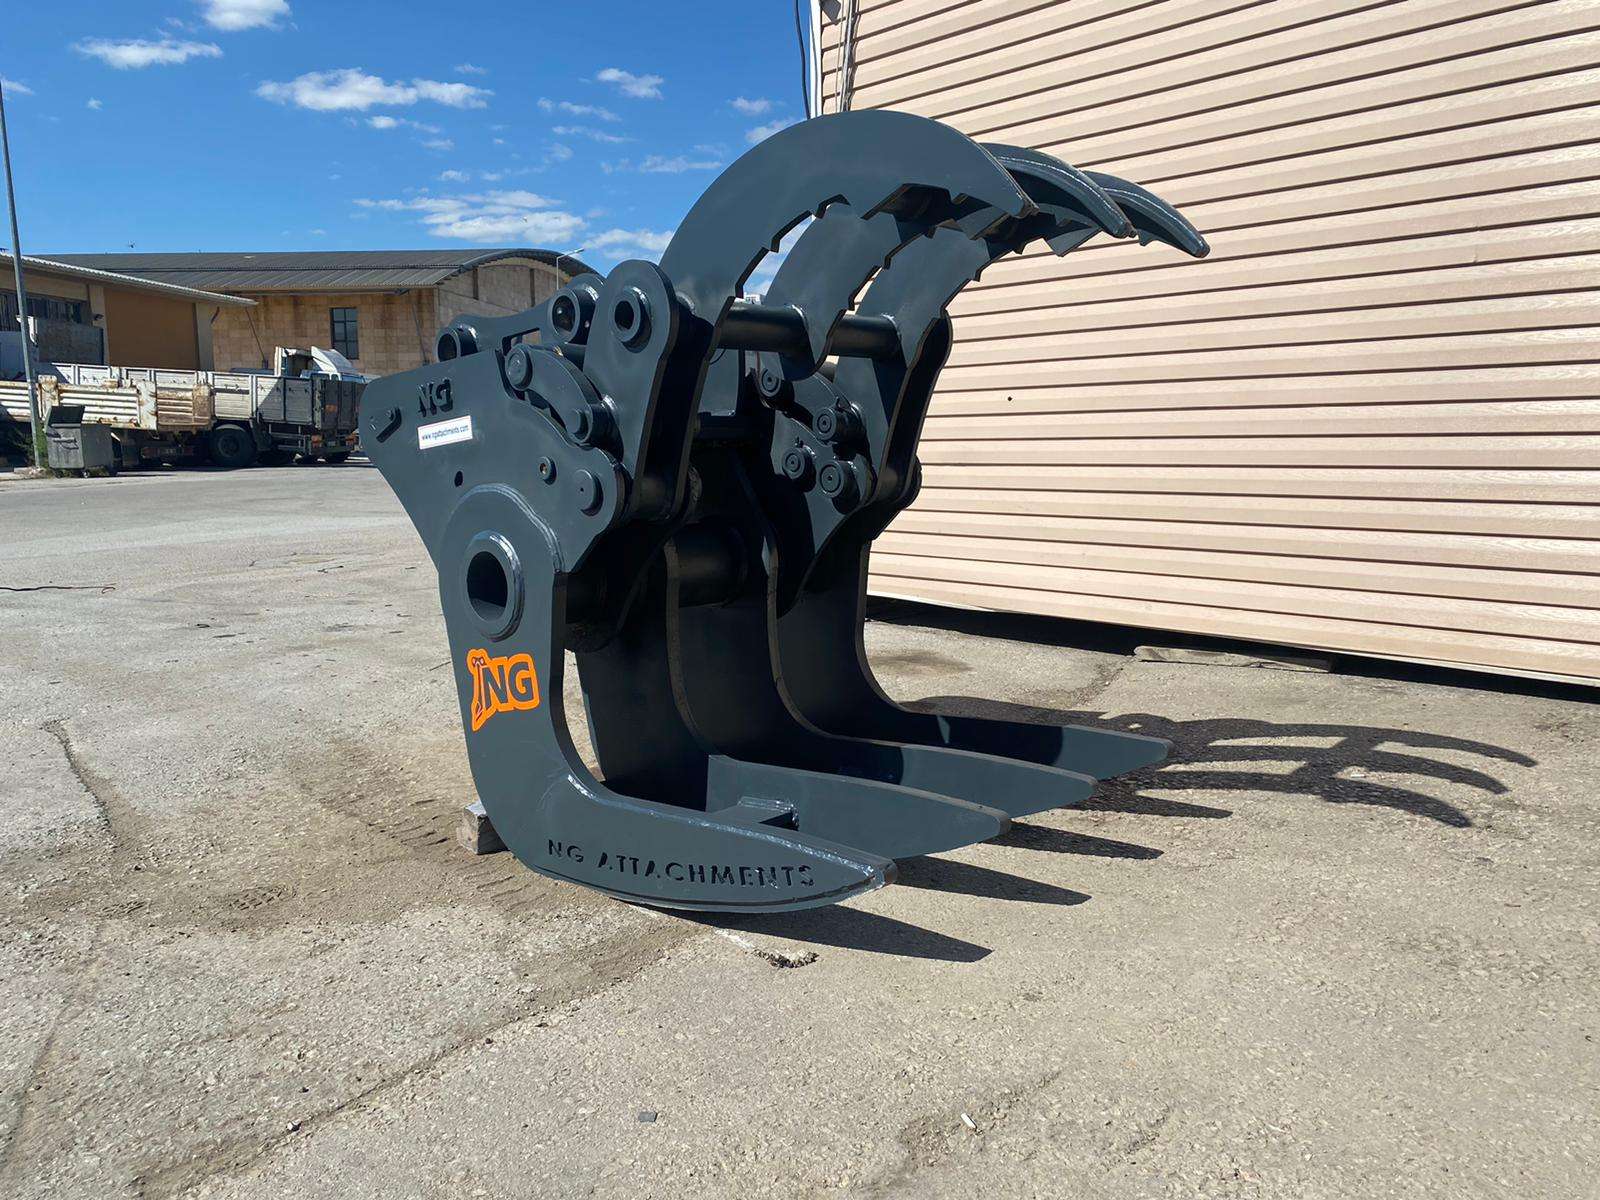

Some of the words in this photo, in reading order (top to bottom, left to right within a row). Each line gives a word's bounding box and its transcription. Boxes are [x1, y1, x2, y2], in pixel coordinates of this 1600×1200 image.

[417, 377, 454, 417] NG
[482, 661, 534, 710] NG
[548, 839, 584, 863] NG
[598, 852, 814, 888] ATTACHMENTS
